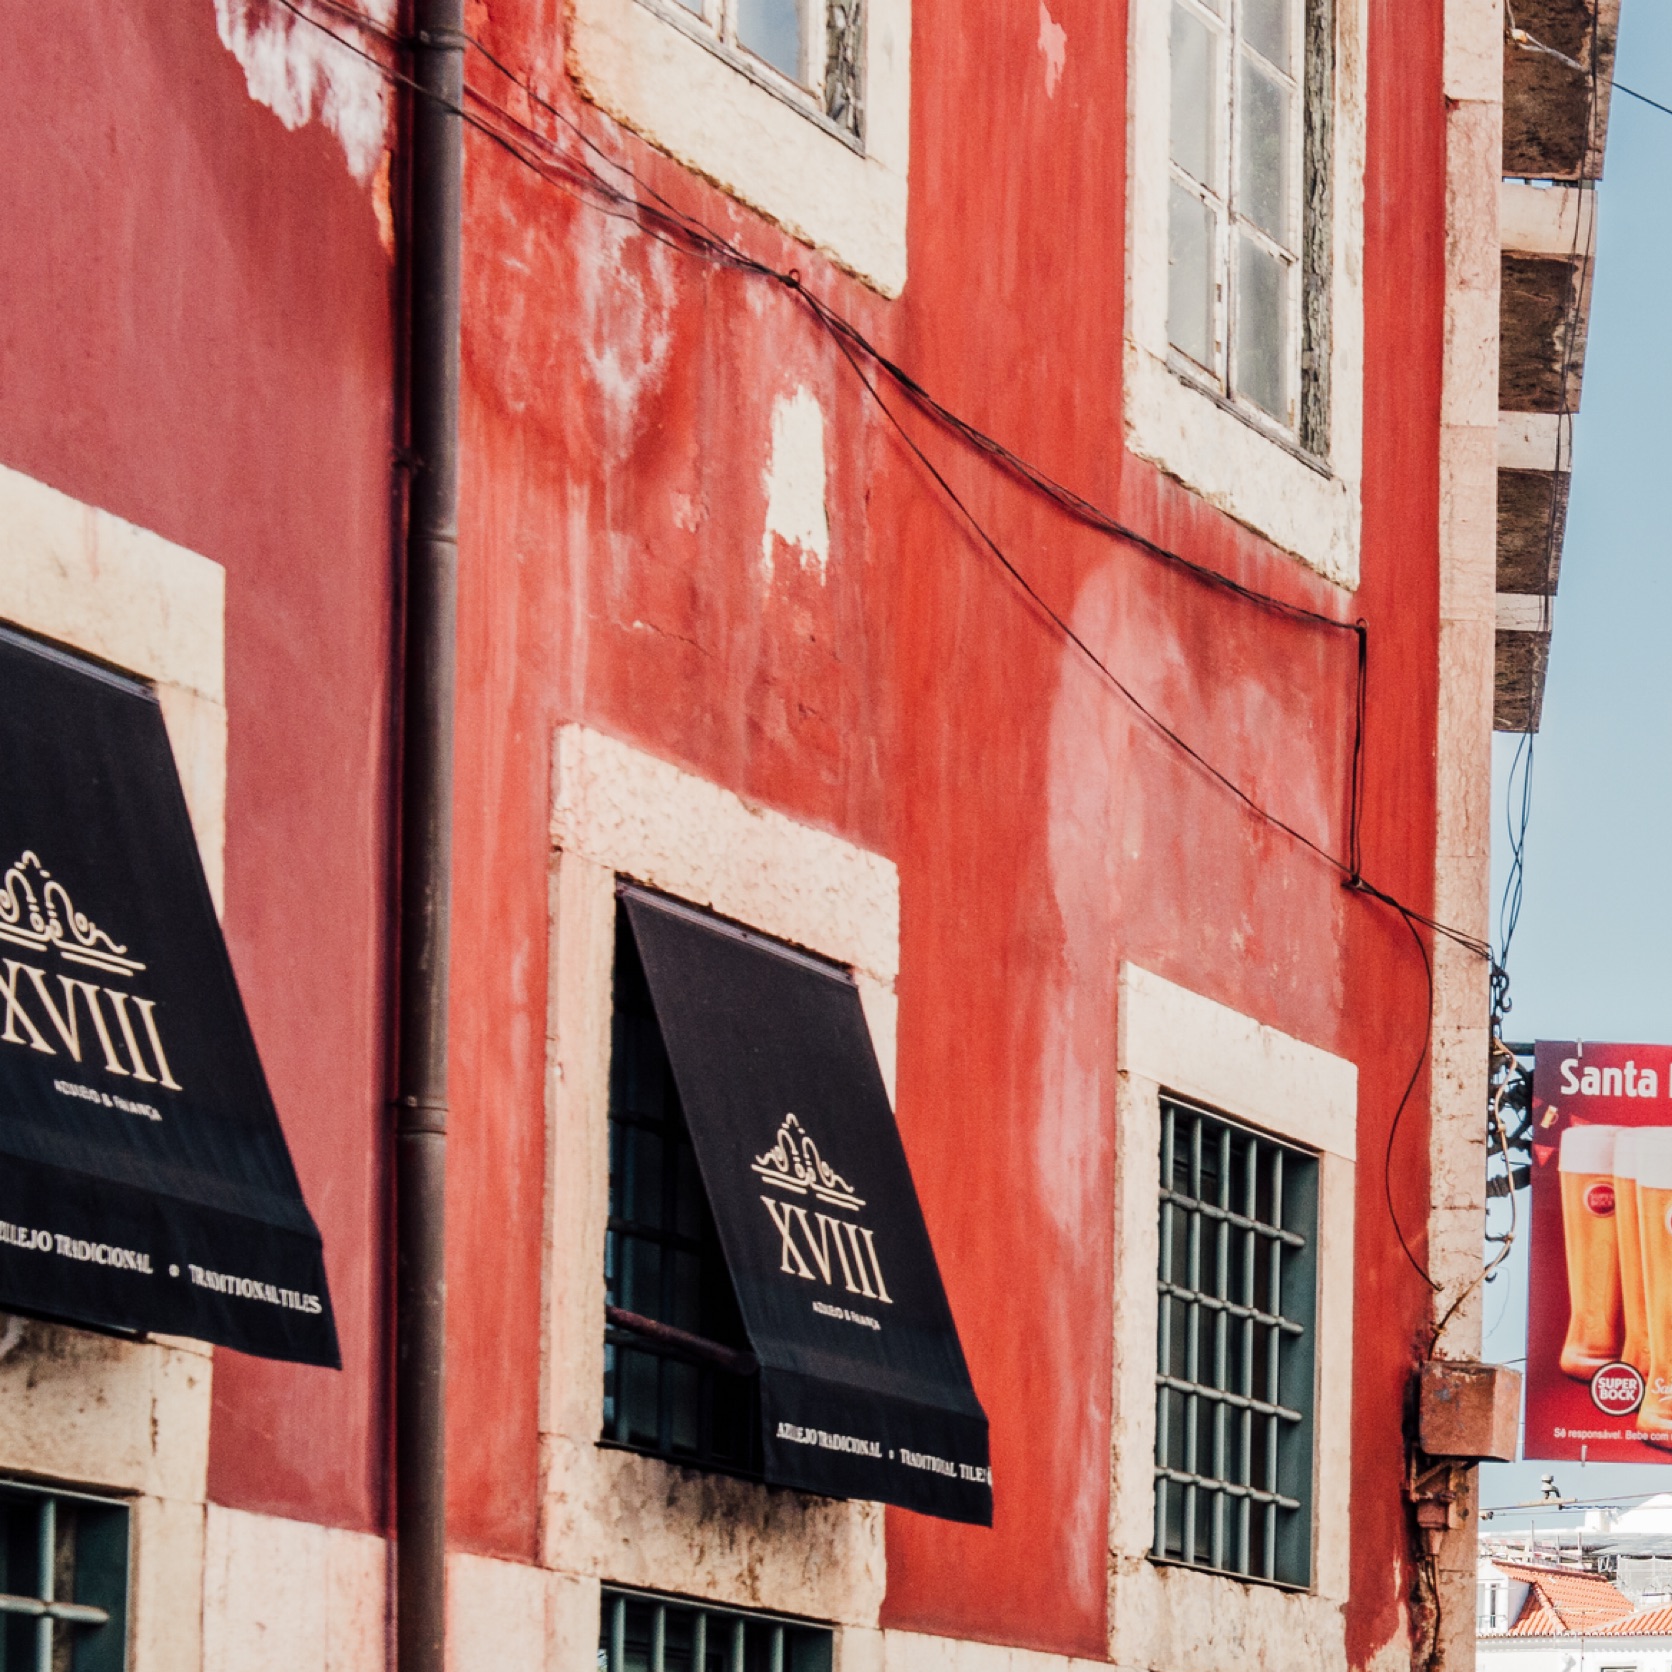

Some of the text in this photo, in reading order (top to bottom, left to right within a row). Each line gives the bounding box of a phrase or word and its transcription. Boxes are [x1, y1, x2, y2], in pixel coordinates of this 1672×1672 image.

[0, 957, 183, 1092] XVIII
[1560, 1058, 1658, 1098] Santa
[54, 1233, 154, 1275] TRADICIONAL
[760, 1194, 894, 1304] XVIII
[1598, 1377, 1637, 1391] SUPER
[1599, 1389, 1636, 1401] BOCK
